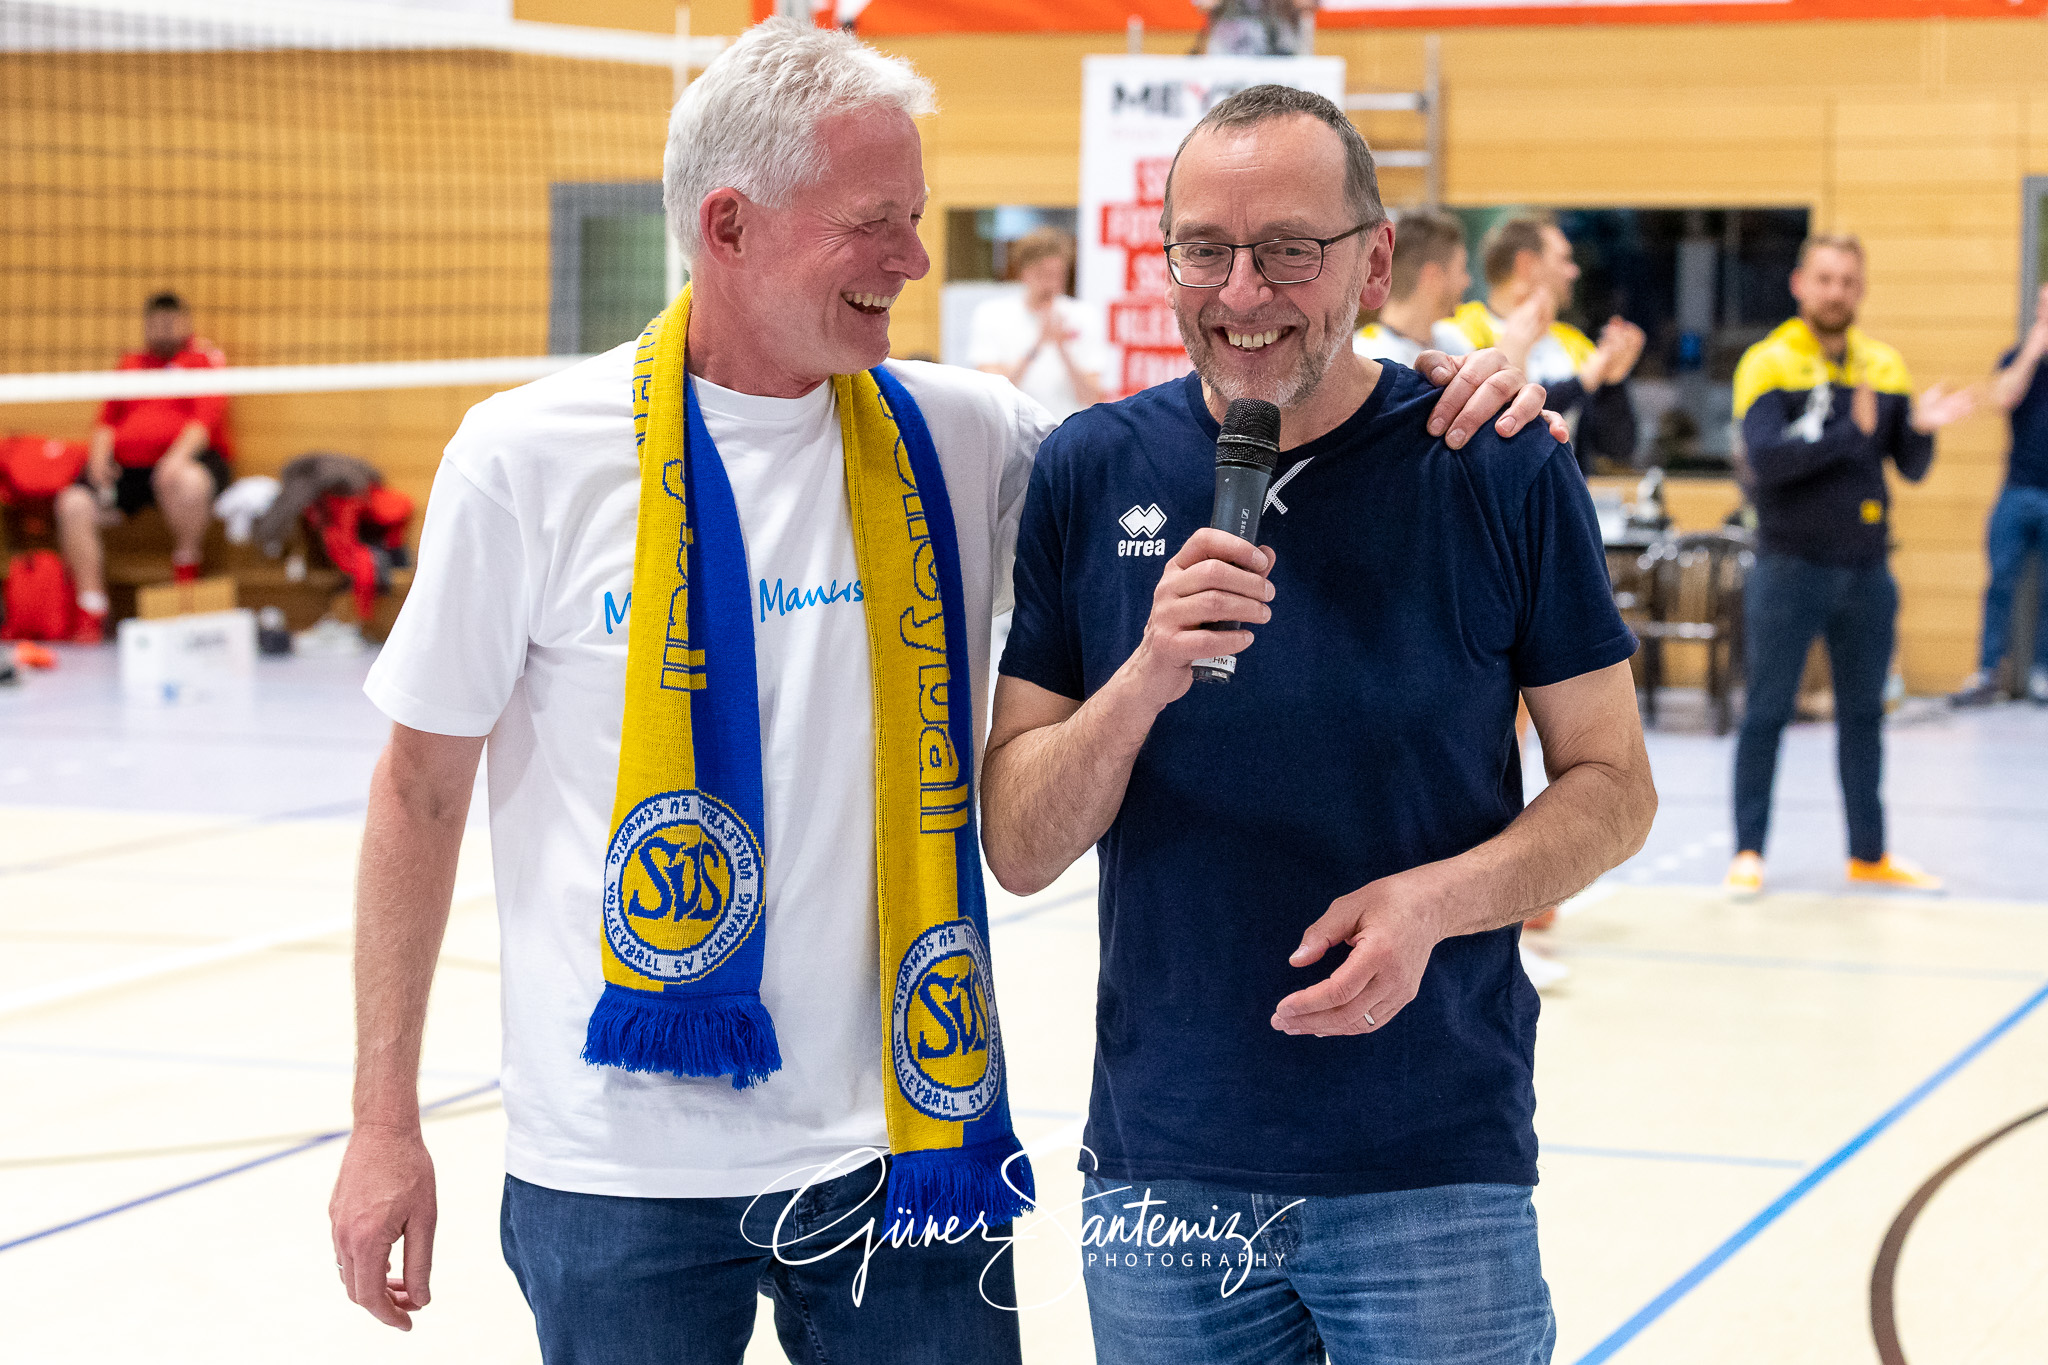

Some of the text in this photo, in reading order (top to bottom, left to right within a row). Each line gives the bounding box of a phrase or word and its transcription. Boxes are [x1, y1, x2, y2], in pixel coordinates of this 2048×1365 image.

[606, 881, 662, 972] VOLLEYBALL
[674, 955, 694, 973] SV
[701, 806, 754, 880] VOLLEYBA
[896, 1031, 959, 1112] VOLLEYBALL
